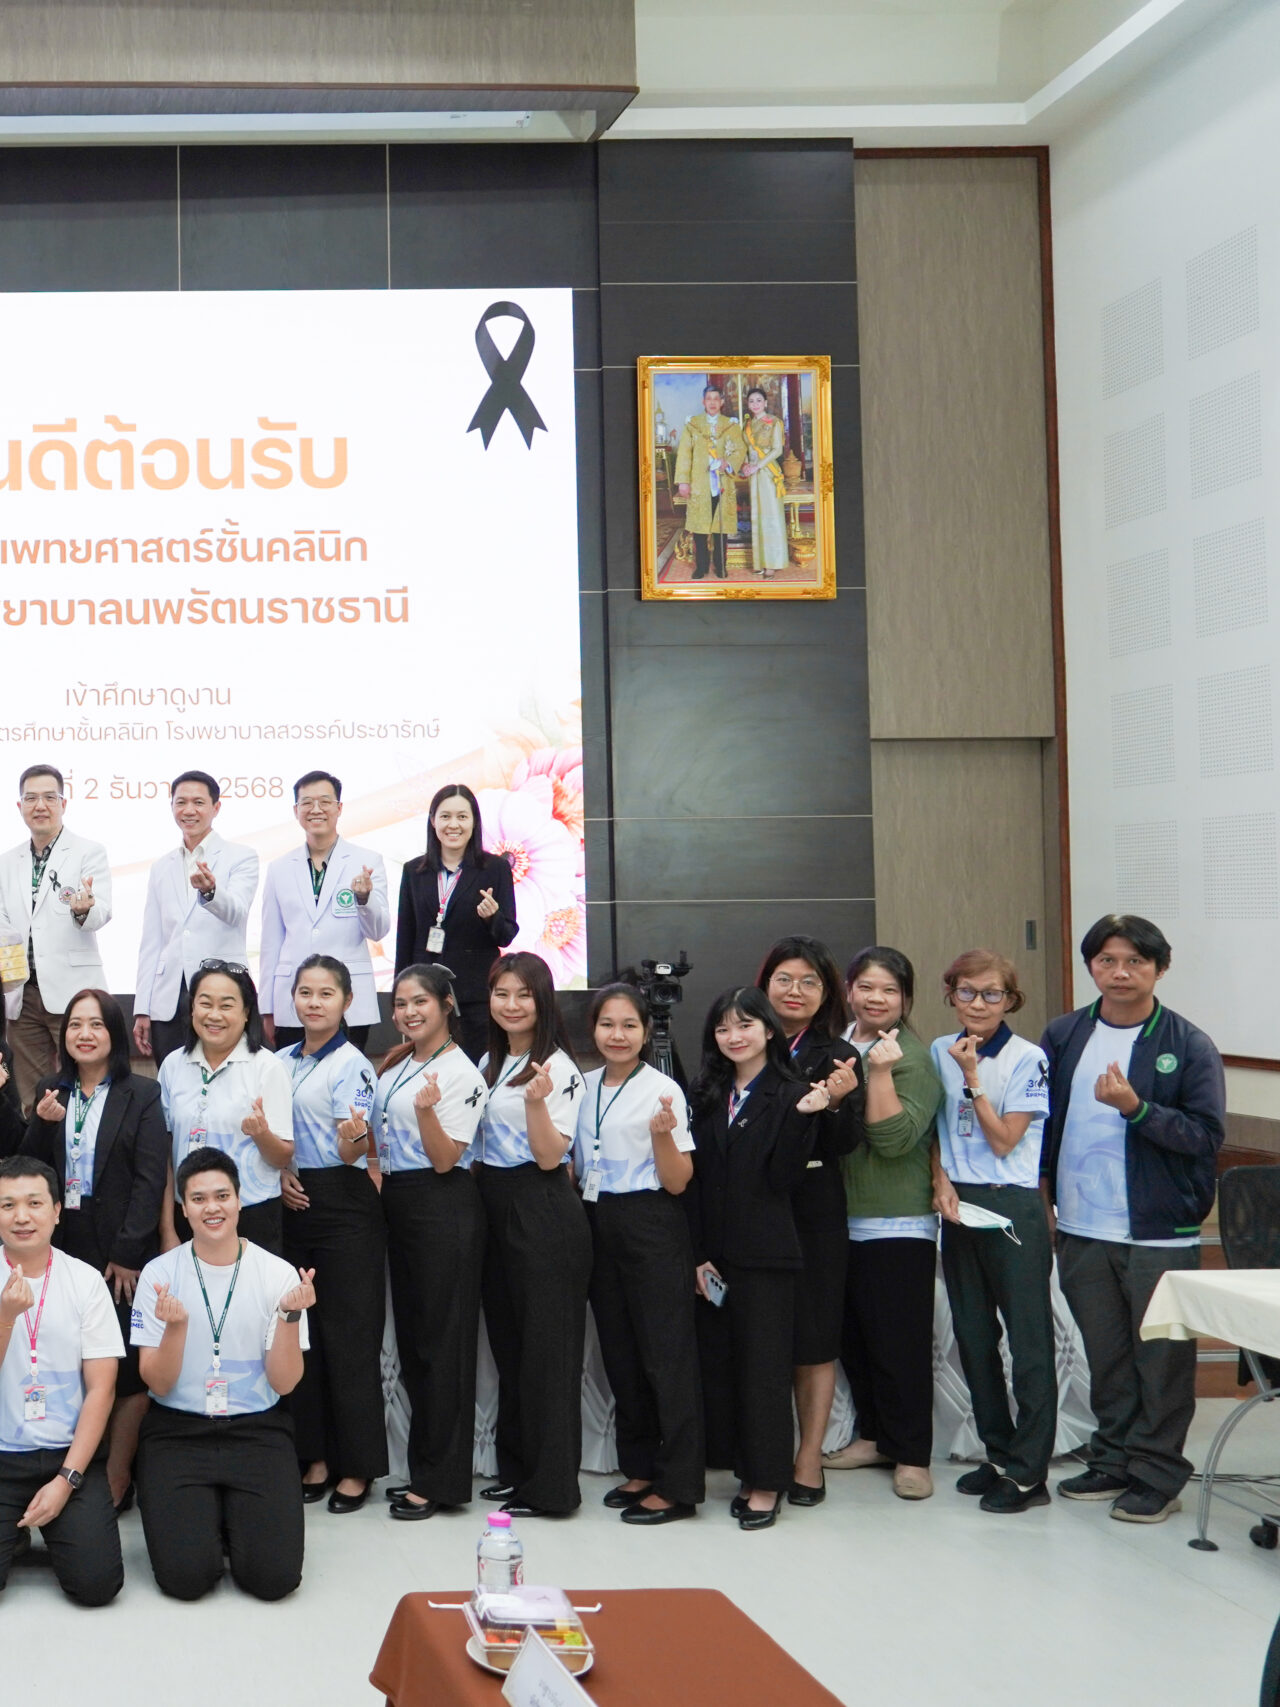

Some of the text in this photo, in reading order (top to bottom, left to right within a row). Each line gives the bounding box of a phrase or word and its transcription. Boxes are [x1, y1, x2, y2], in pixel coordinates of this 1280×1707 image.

[66, 681, 231, 714] เข้าศึกษาดูงาน
[166, 718, 441, 741] โรงพยาบาลสวรรค์ประชารักษ์
[84, 778, 99, 800] 2
[110, 774, 171, 800] ธันวา
[219, 776, 284, 799] 2568
